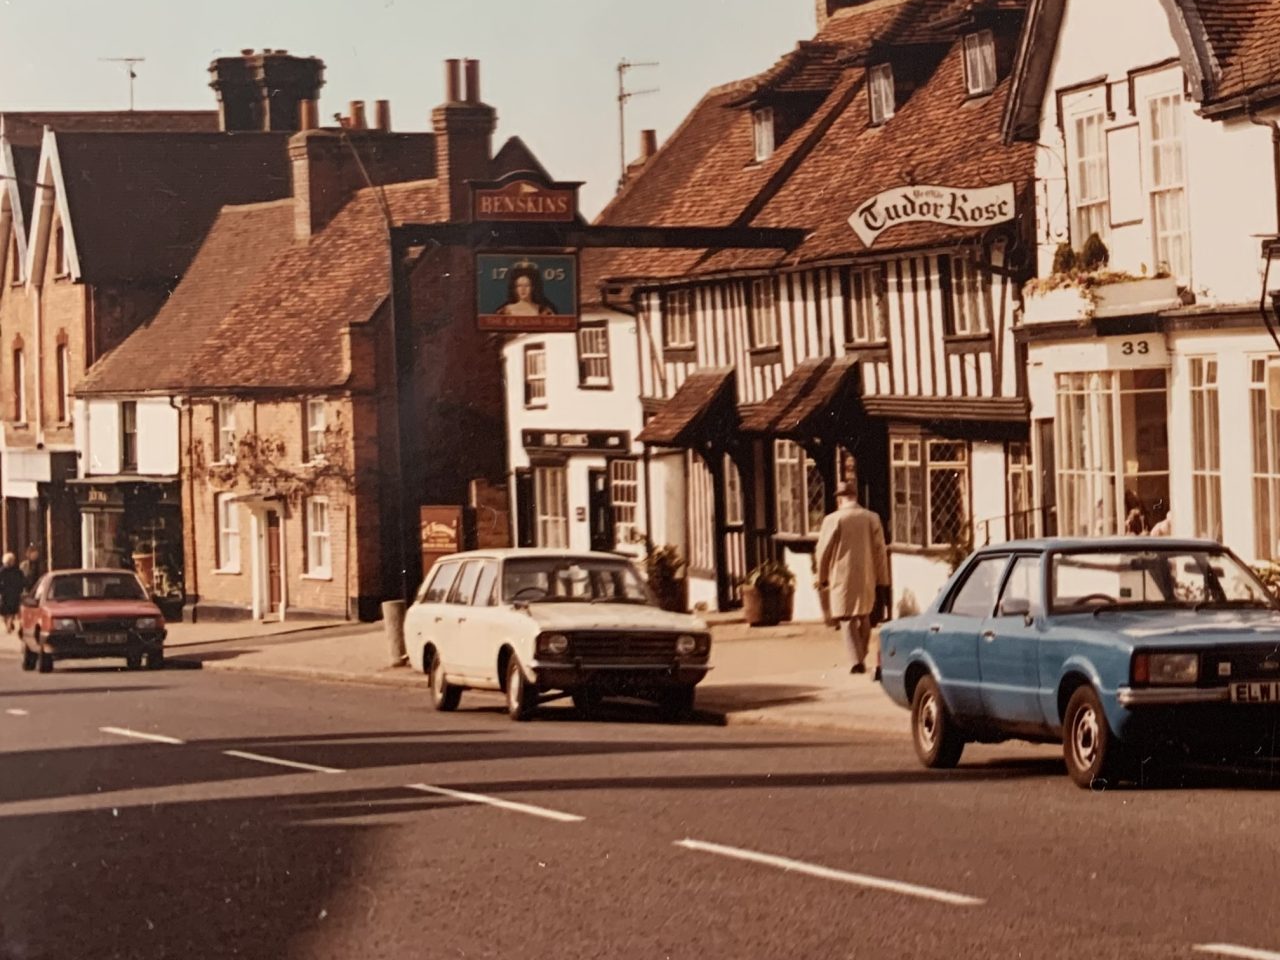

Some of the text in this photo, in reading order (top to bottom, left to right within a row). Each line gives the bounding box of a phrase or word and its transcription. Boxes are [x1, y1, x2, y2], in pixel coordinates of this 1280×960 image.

[481, 196, 567, 214] BENSKINS
[859, 193, 1008, 231] Tudor Rose
[492, 268, 565, 280] 17 05
[1122, 341, 1149, 355] 33
